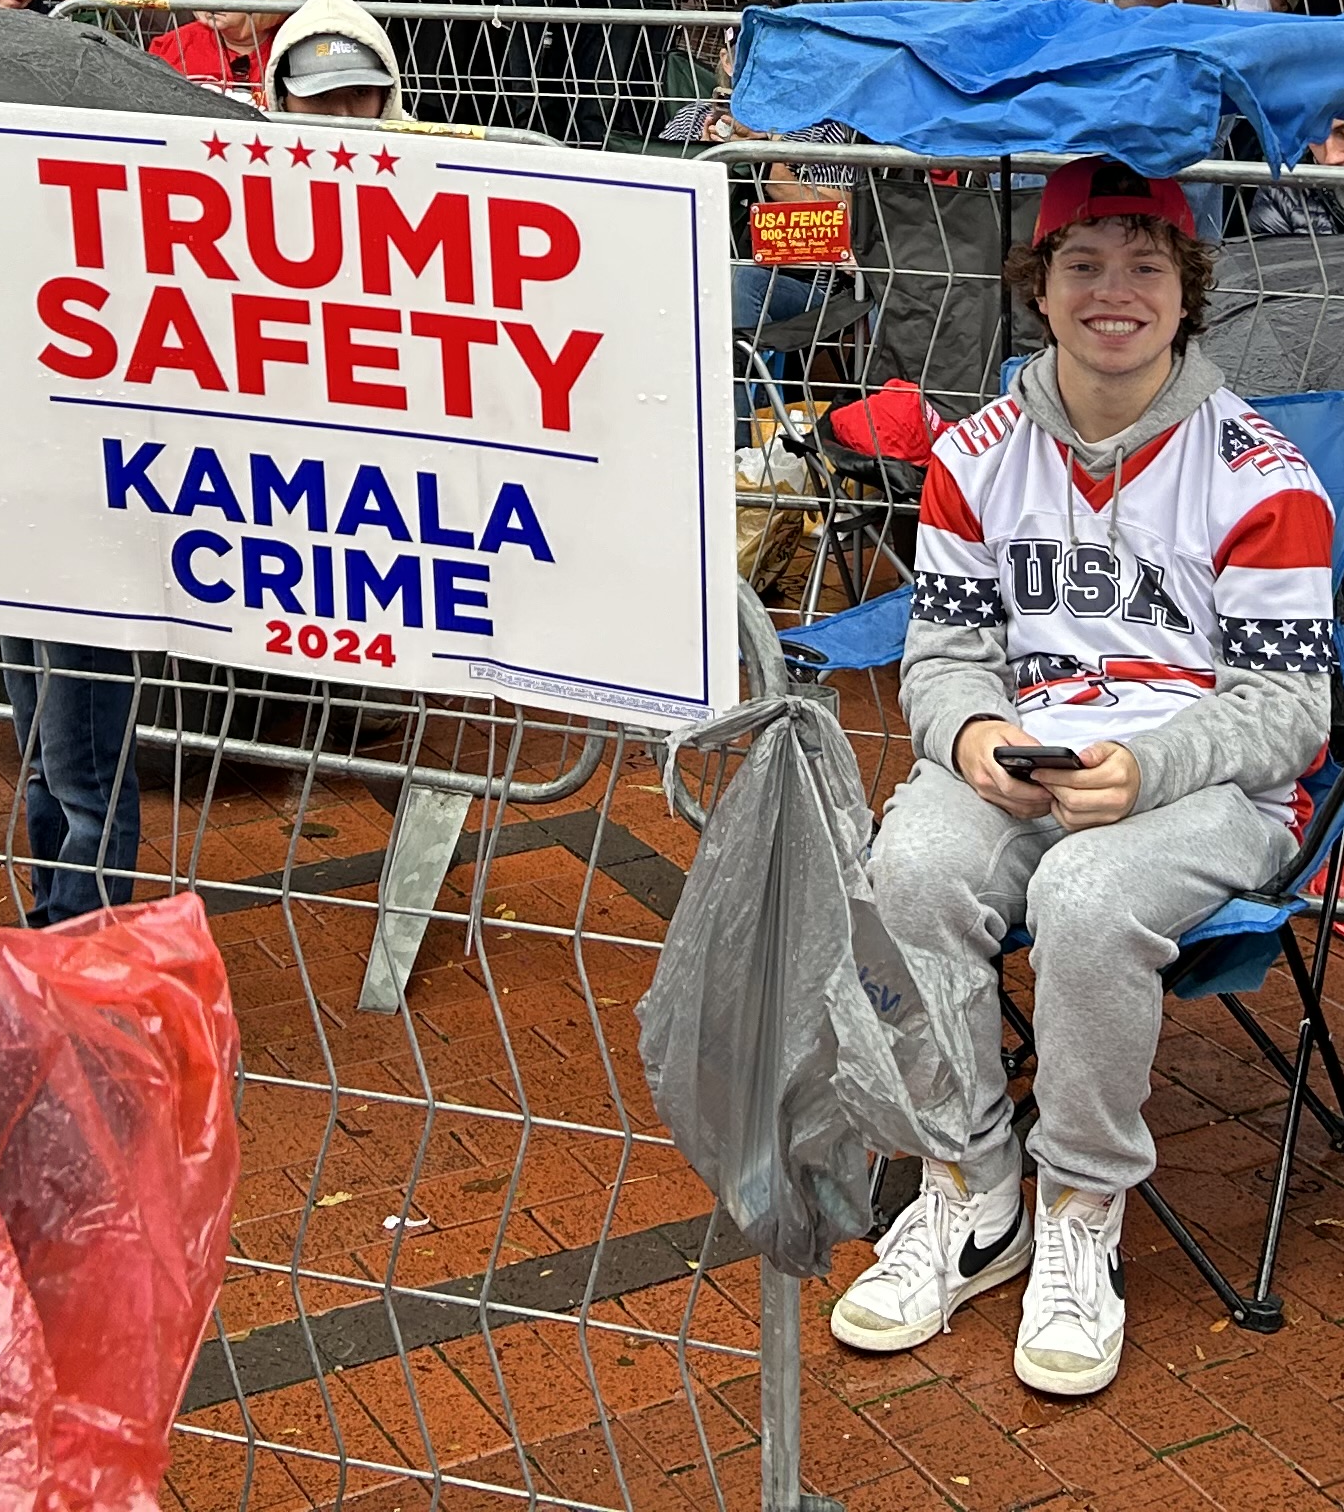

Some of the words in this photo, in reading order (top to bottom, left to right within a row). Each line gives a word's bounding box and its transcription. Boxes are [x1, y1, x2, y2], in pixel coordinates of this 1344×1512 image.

[329, 40, 359, 55] Altec
[37, 158, 581, 311] TRUMP
[754, 211, 786, 229] USA
[789, 209, 844, 227] FENCE
[760, 226, 839, 241] 800-741-1711
[36, 276, 603, 432] SAFETY
[103, 438, 554, 563] KAMALA
[171, 529, 494, 637] CRIME
[1007, 538, 1194, 634] USA
[265, 619, 397, 669] 2024
